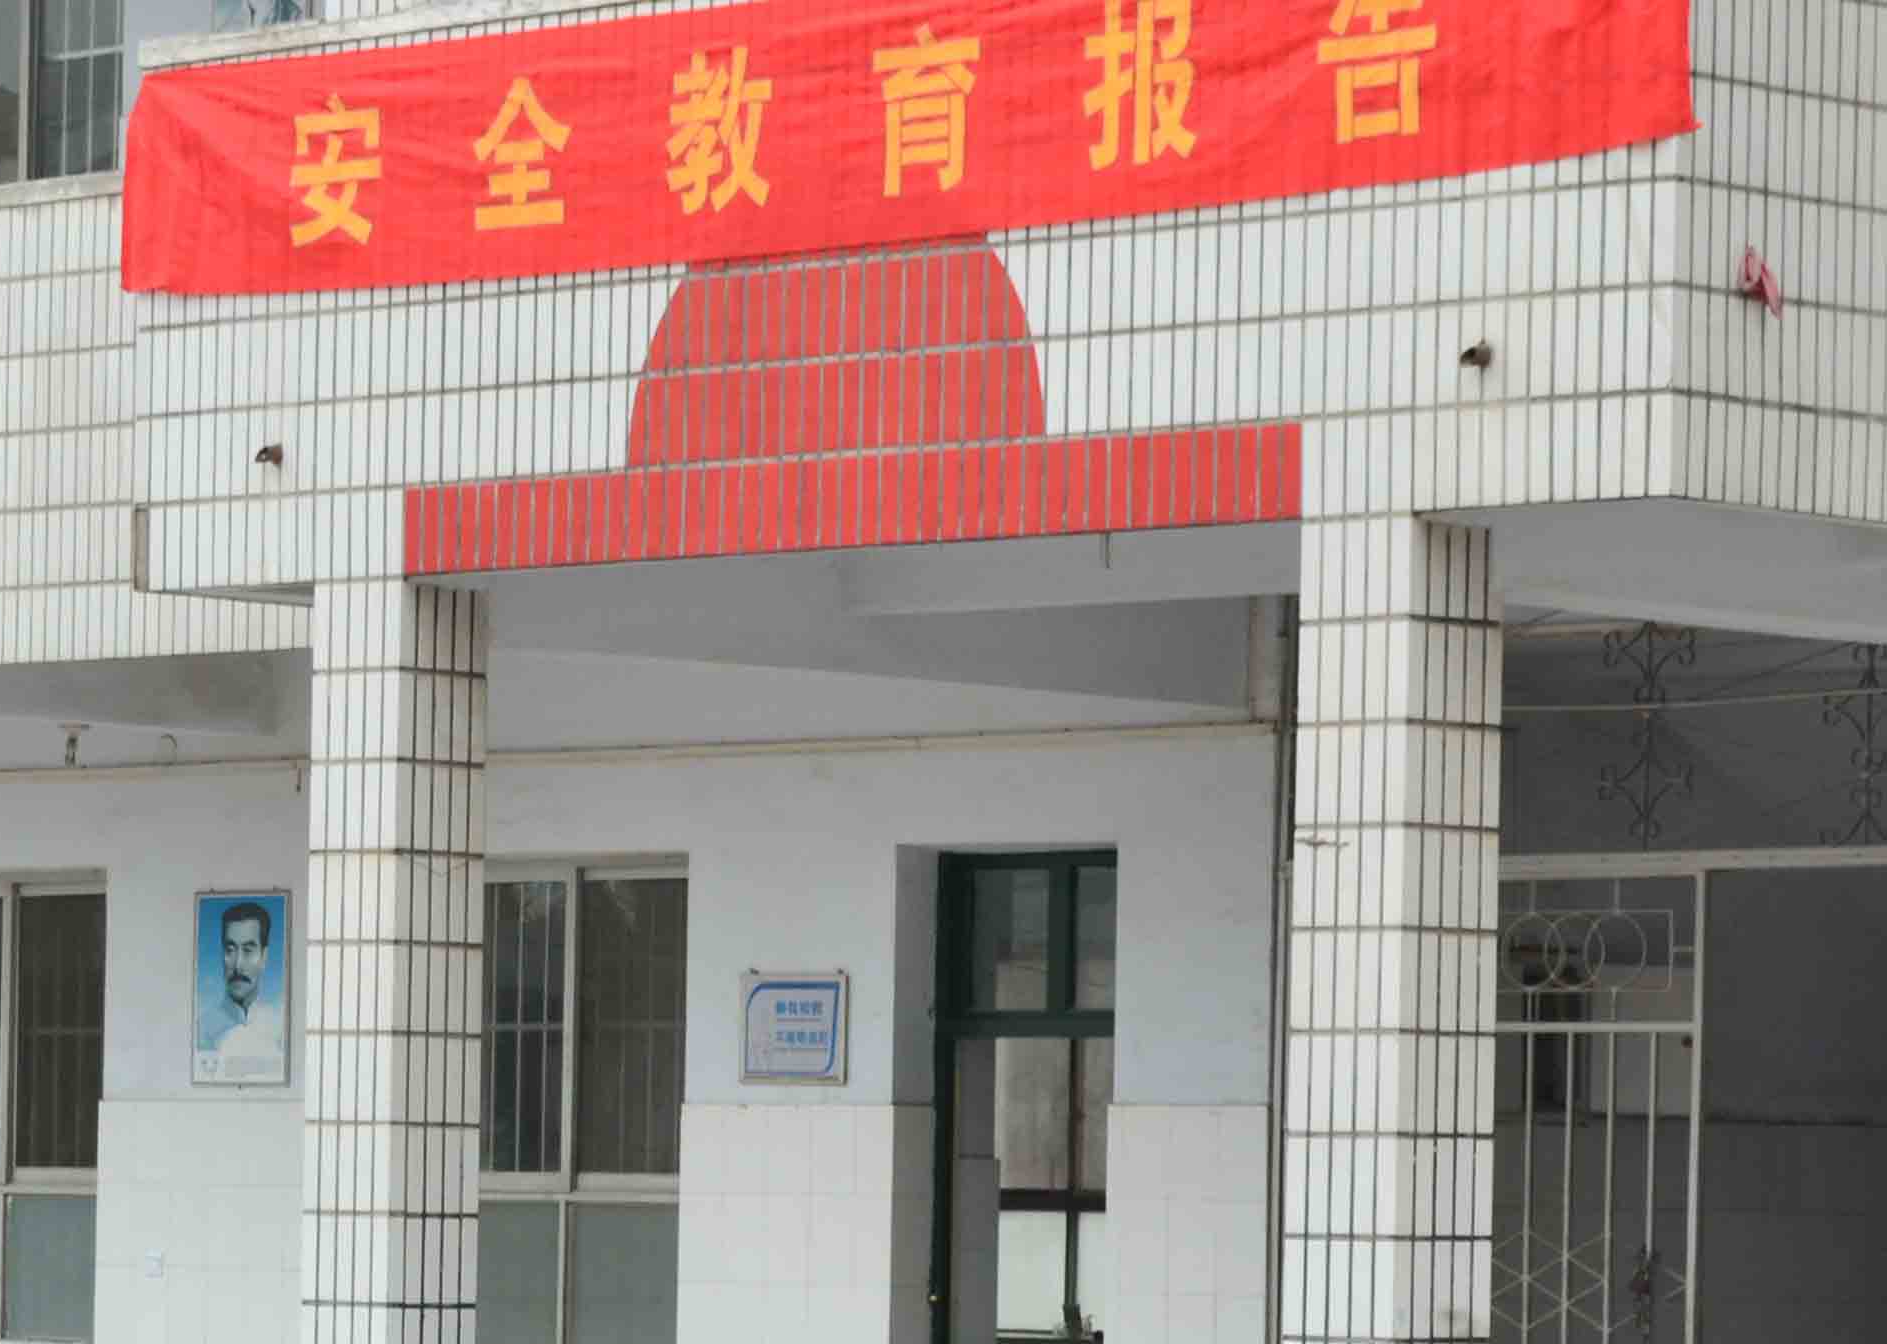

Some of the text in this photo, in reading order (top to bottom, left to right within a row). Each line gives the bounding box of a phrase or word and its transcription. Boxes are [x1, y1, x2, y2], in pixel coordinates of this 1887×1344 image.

[290, 0, 1437, 249] 安全教育报告
